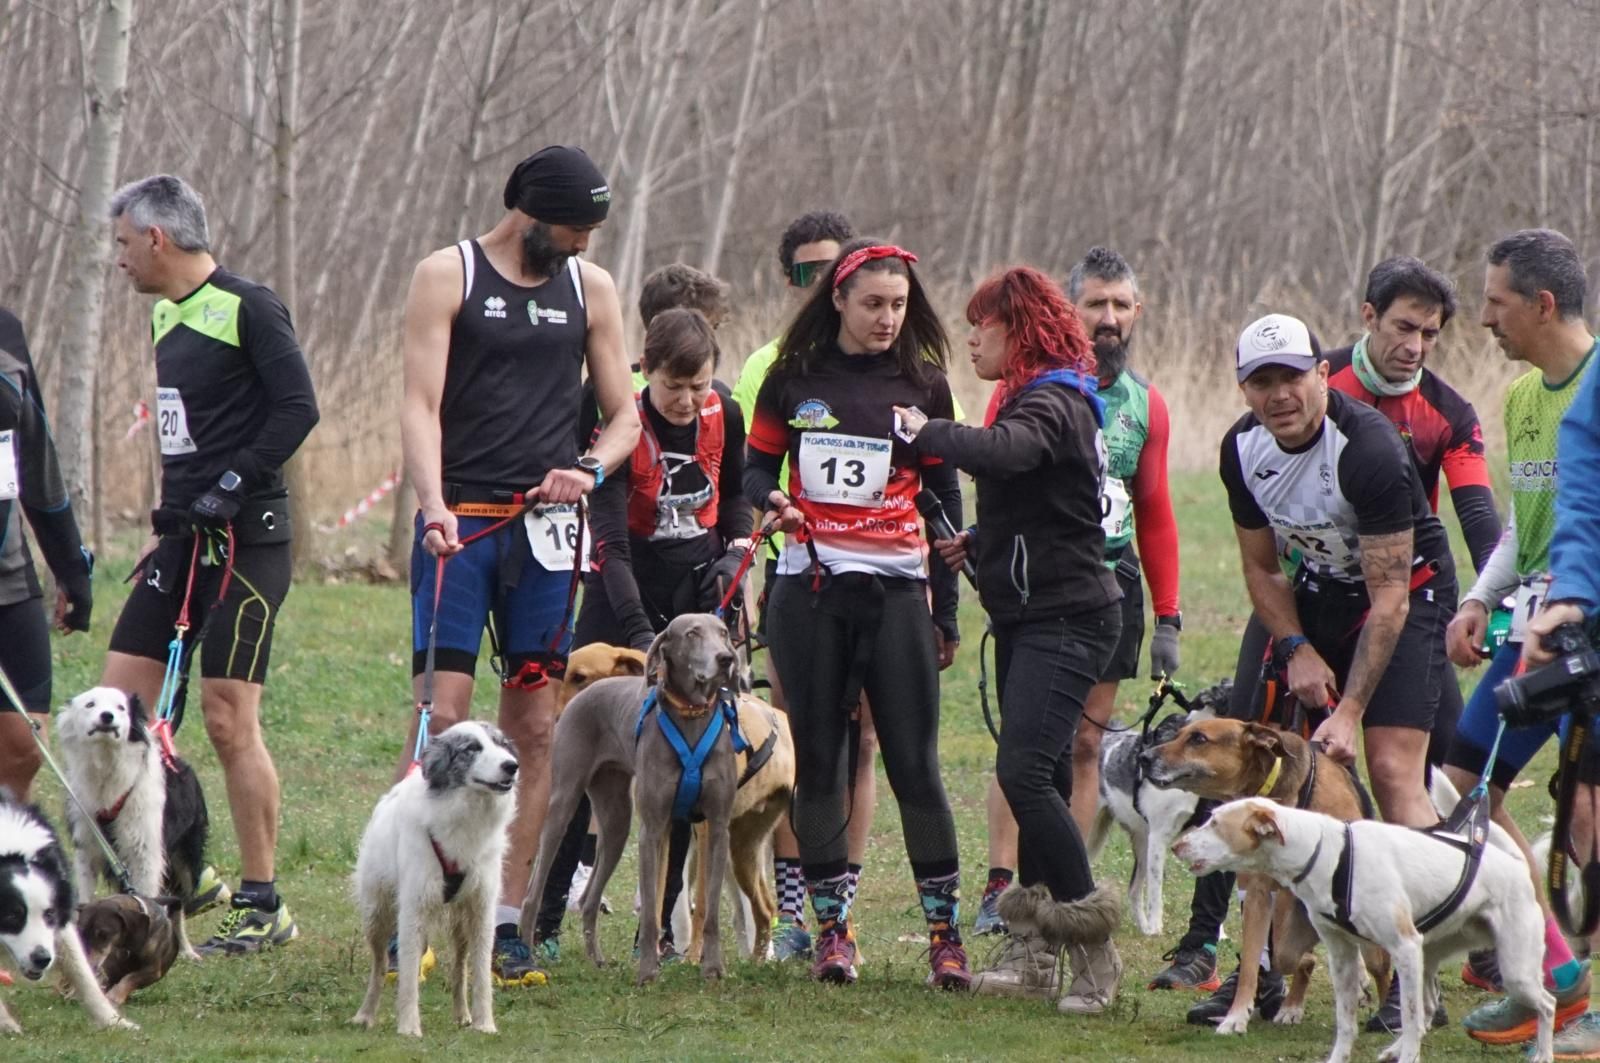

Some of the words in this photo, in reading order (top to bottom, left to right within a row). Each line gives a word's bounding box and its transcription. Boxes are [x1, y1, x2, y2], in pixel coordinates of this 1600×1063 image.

[161, 409, 178, 437] 20
[820, 457, 866, 488] 13
[545, 523, 578, 551] 16
[1289, 533, 1333, 556] 12
